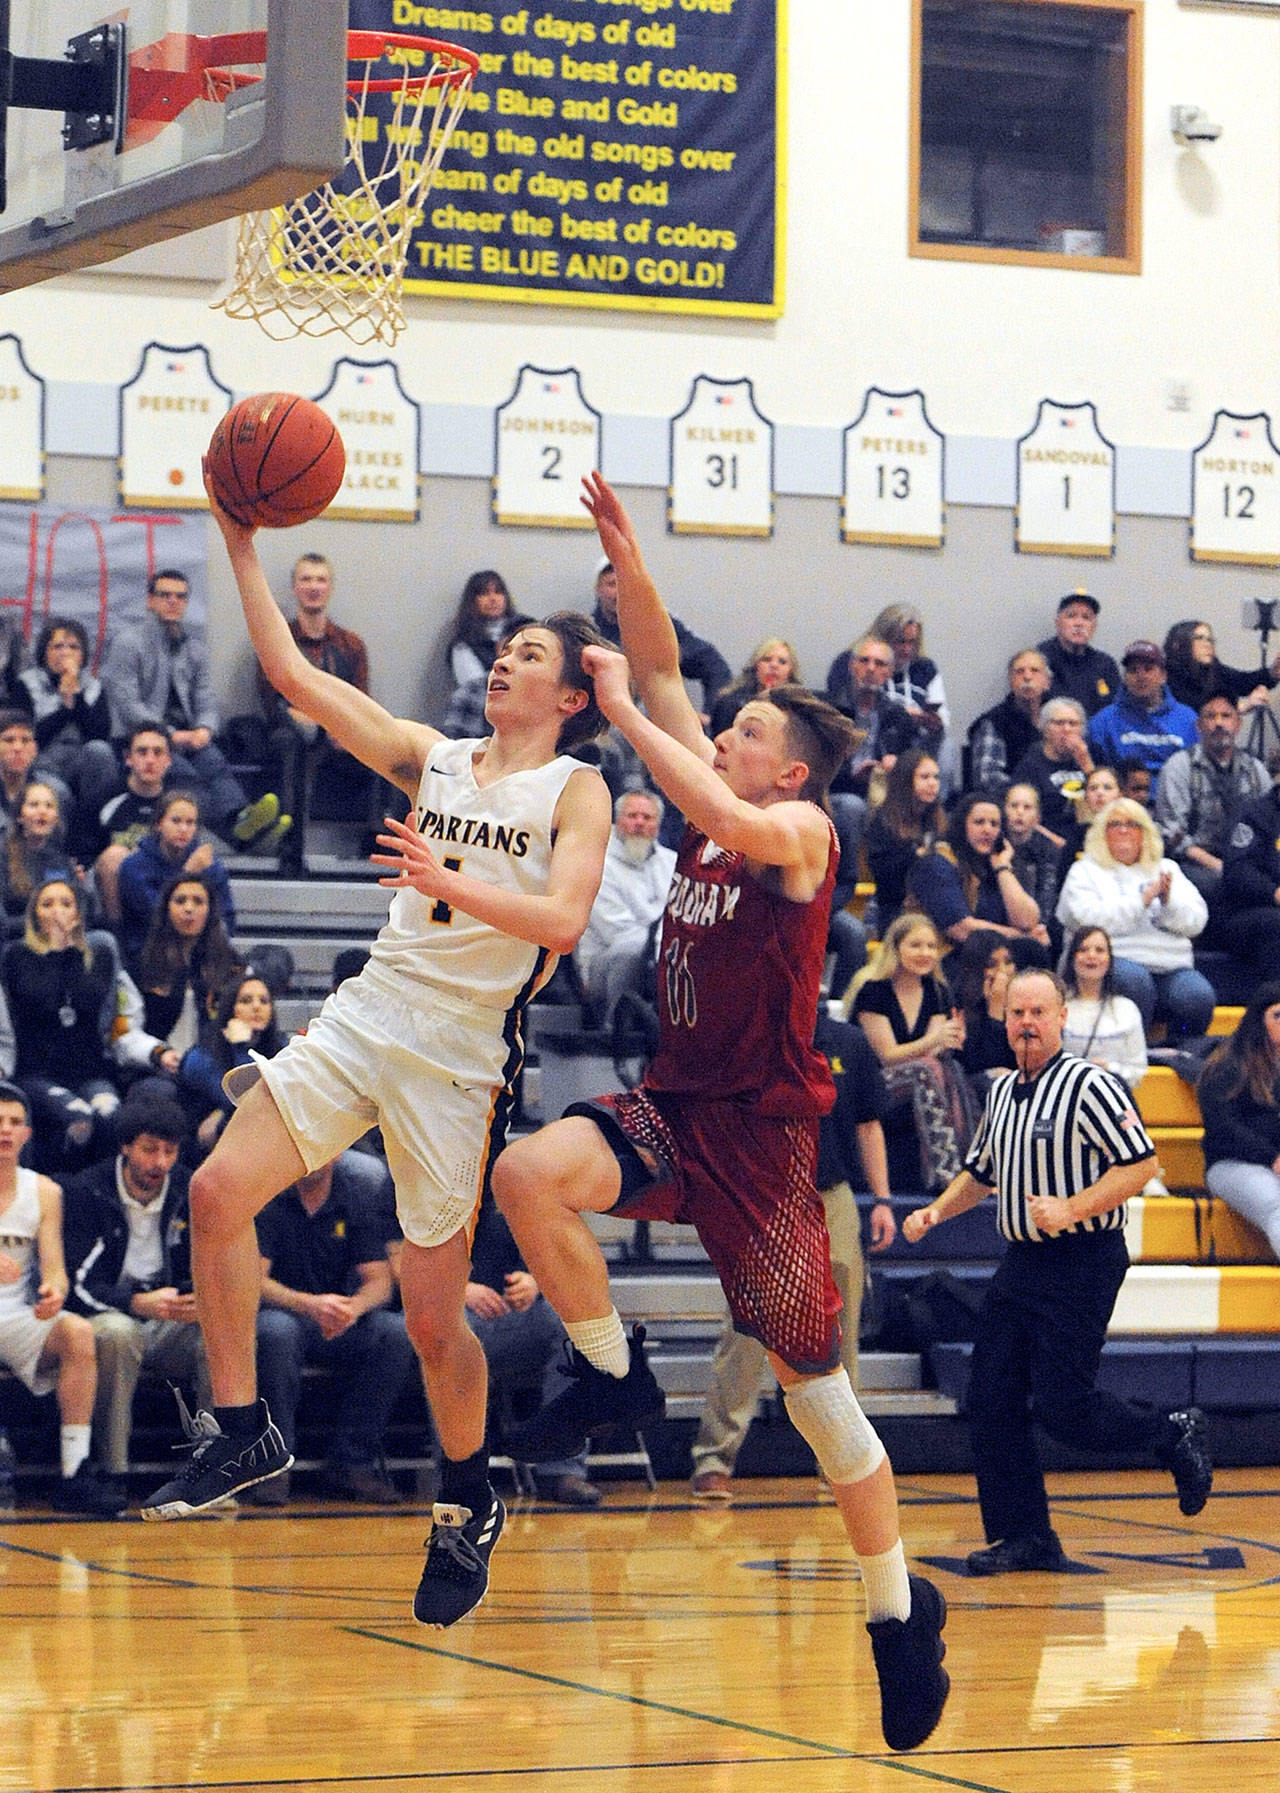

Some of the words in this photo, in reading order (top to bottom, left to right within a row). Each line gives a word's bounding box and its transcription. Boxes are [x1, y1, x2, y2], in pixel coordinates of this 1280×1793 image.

[393, 0, 493, 33] Dreams
[501, 10, 529, 35] of
[534, 13, 597, 46] days
[603, 19, 631, 44] of
[636, 22, 676, 48] old
[512, 50, 555, 78] the
[561, 54, 619, 84] best
[625, 60, 653, 86] of
[657, 64, 738, 93] colors
[496, 87, 556, 118] Blue
[561, 96, 610, 123] and
[616, 97, 678, 128] Gold
[495, 128, 538, 156] the
[543, 132, 585, 160] old
[591, 141, 675, 172] songs
[680, 149, 736, 172] over
[400, 160, 488, 191] Deam
[493, 167, 522, 195] of
[527, 170, 589, 205] days
[595, 176, 623, 202] of
[627, 179, 668, 206] old
[431, 203, 505, 233] cheer
[511, 208, 554, 237] the
[561, 212, 618, 242] best
[623, 217, 652, 244] of
[656, 221, 737, 251] colors
[415, 240, 474, 271] THE
[481, 245, 559, 277] BLUE
[565, 252, 629, 282] AND
[635, 257, 725, 288] GOLD!
[502, 417, 594, 435] JOHNSON
[686, 426, 757, 443] KILMER
[541, 445, 562, 480] 2
[862, 437, 927, 456] PETERS
[1024, 448, 1109, 467] SANDOVAL
[706, 453, 738, 490] 31
[877, 465, 911, 500] 13
[1203, 456, 1274, 475] HORTON
[1062, 475, 1070, 511] 1
[1224, 484, 1256, 519] 12
